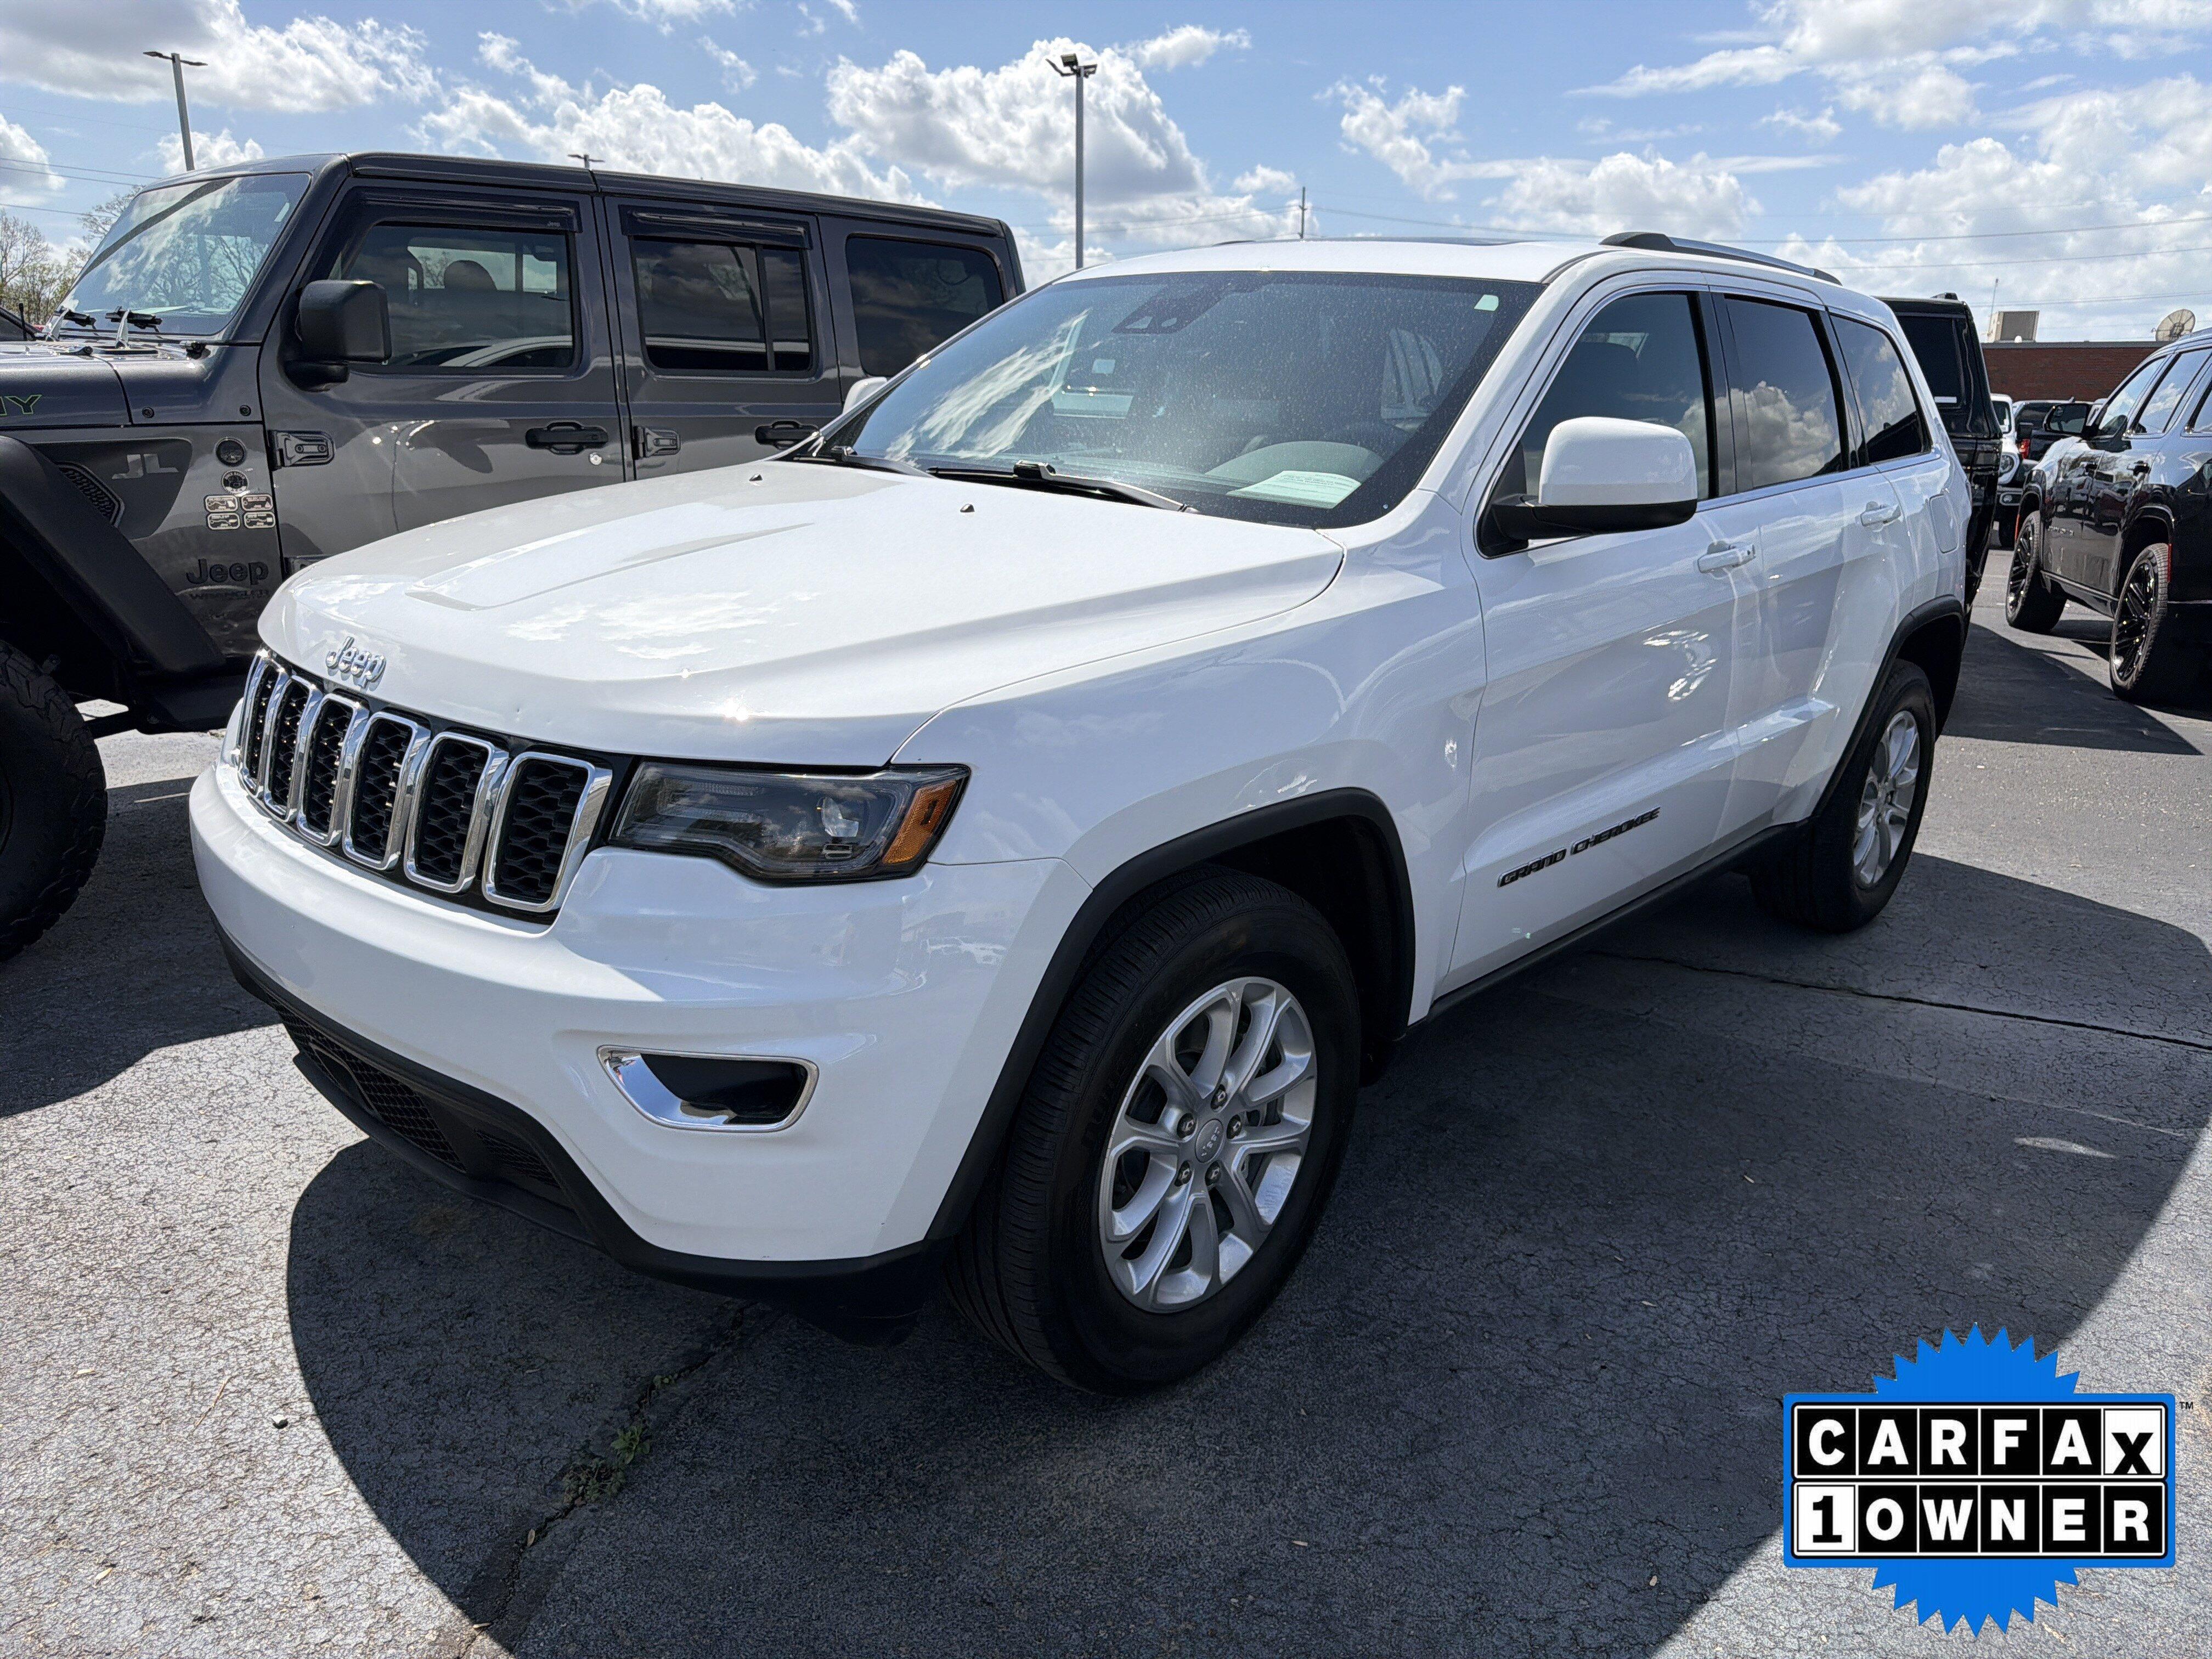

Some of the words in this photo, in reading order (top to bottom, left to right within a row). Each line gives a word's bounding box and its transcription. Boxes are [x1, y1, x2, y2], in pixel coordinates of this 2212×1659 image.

[186, 557, 269, 585] Jeep
[325, 635, 387, 689] Jeep
[1497, 847, 1567, 888] GRAND
[1570, 805, 1661, 856] CHEROKEE
